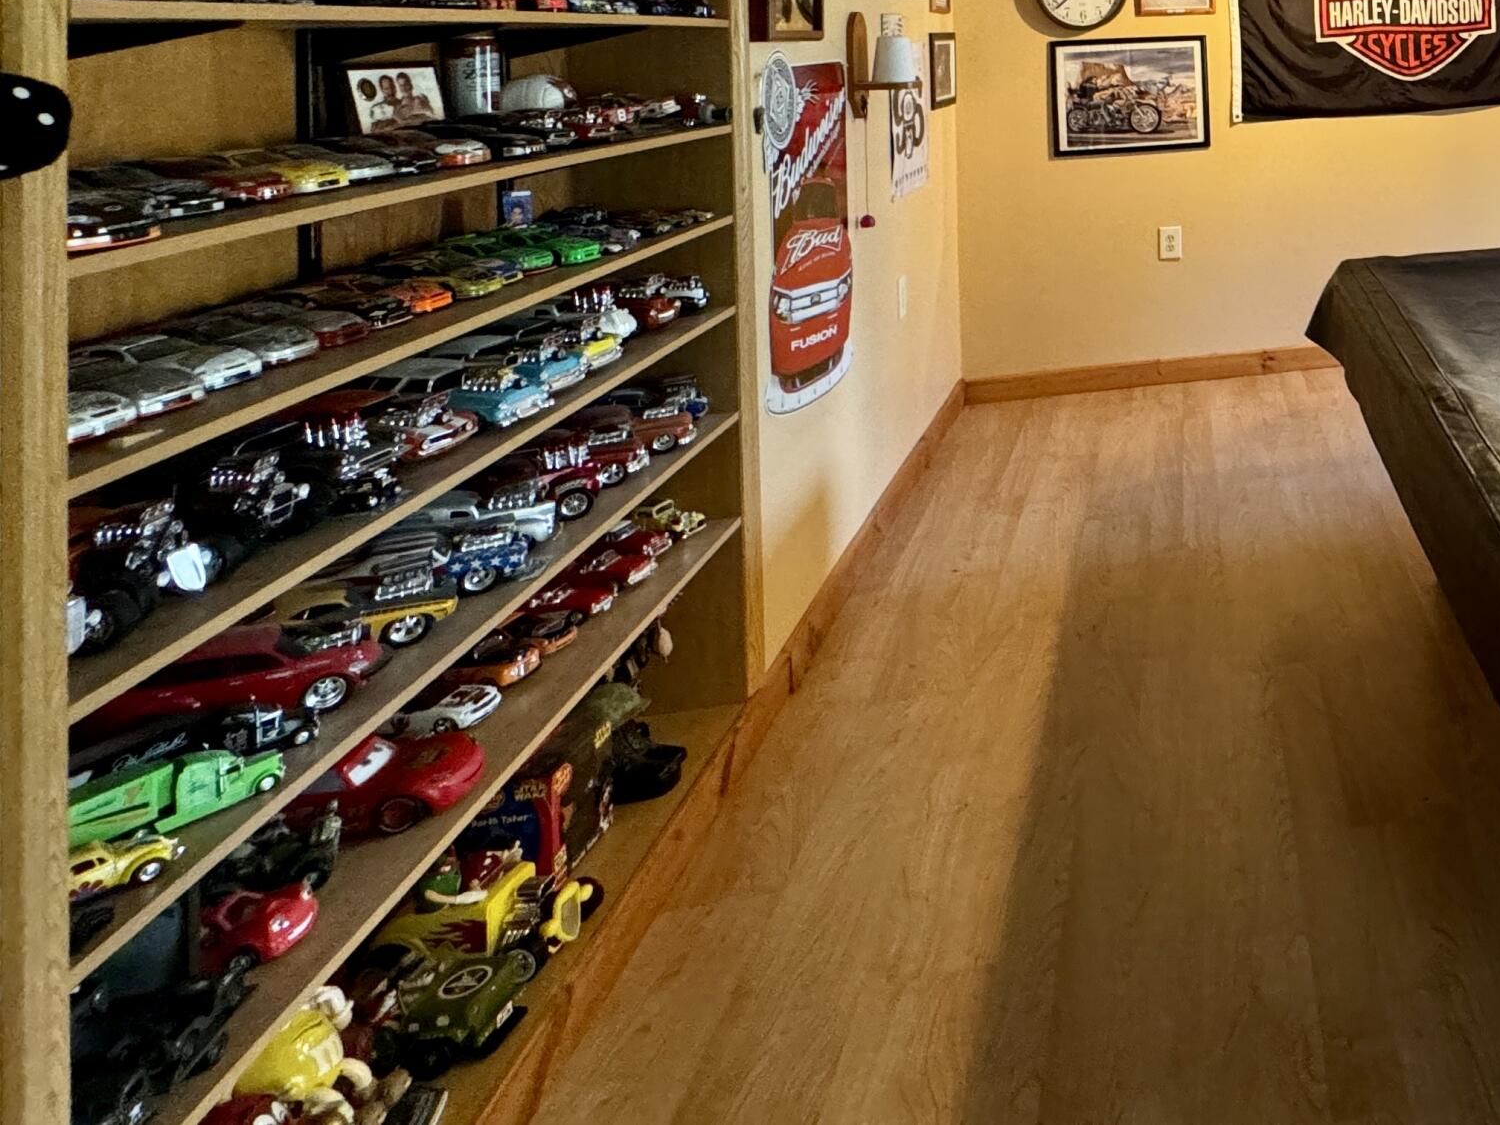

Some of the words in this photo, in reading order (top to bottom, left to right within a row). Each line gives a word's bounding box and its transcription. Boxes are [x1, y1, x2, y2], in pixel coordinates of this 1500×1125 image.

[1367, 33, 1447, 67] CYCLES
[787, 226, 840, 264] Bud
[791, 324, 838, 352] FUSION
